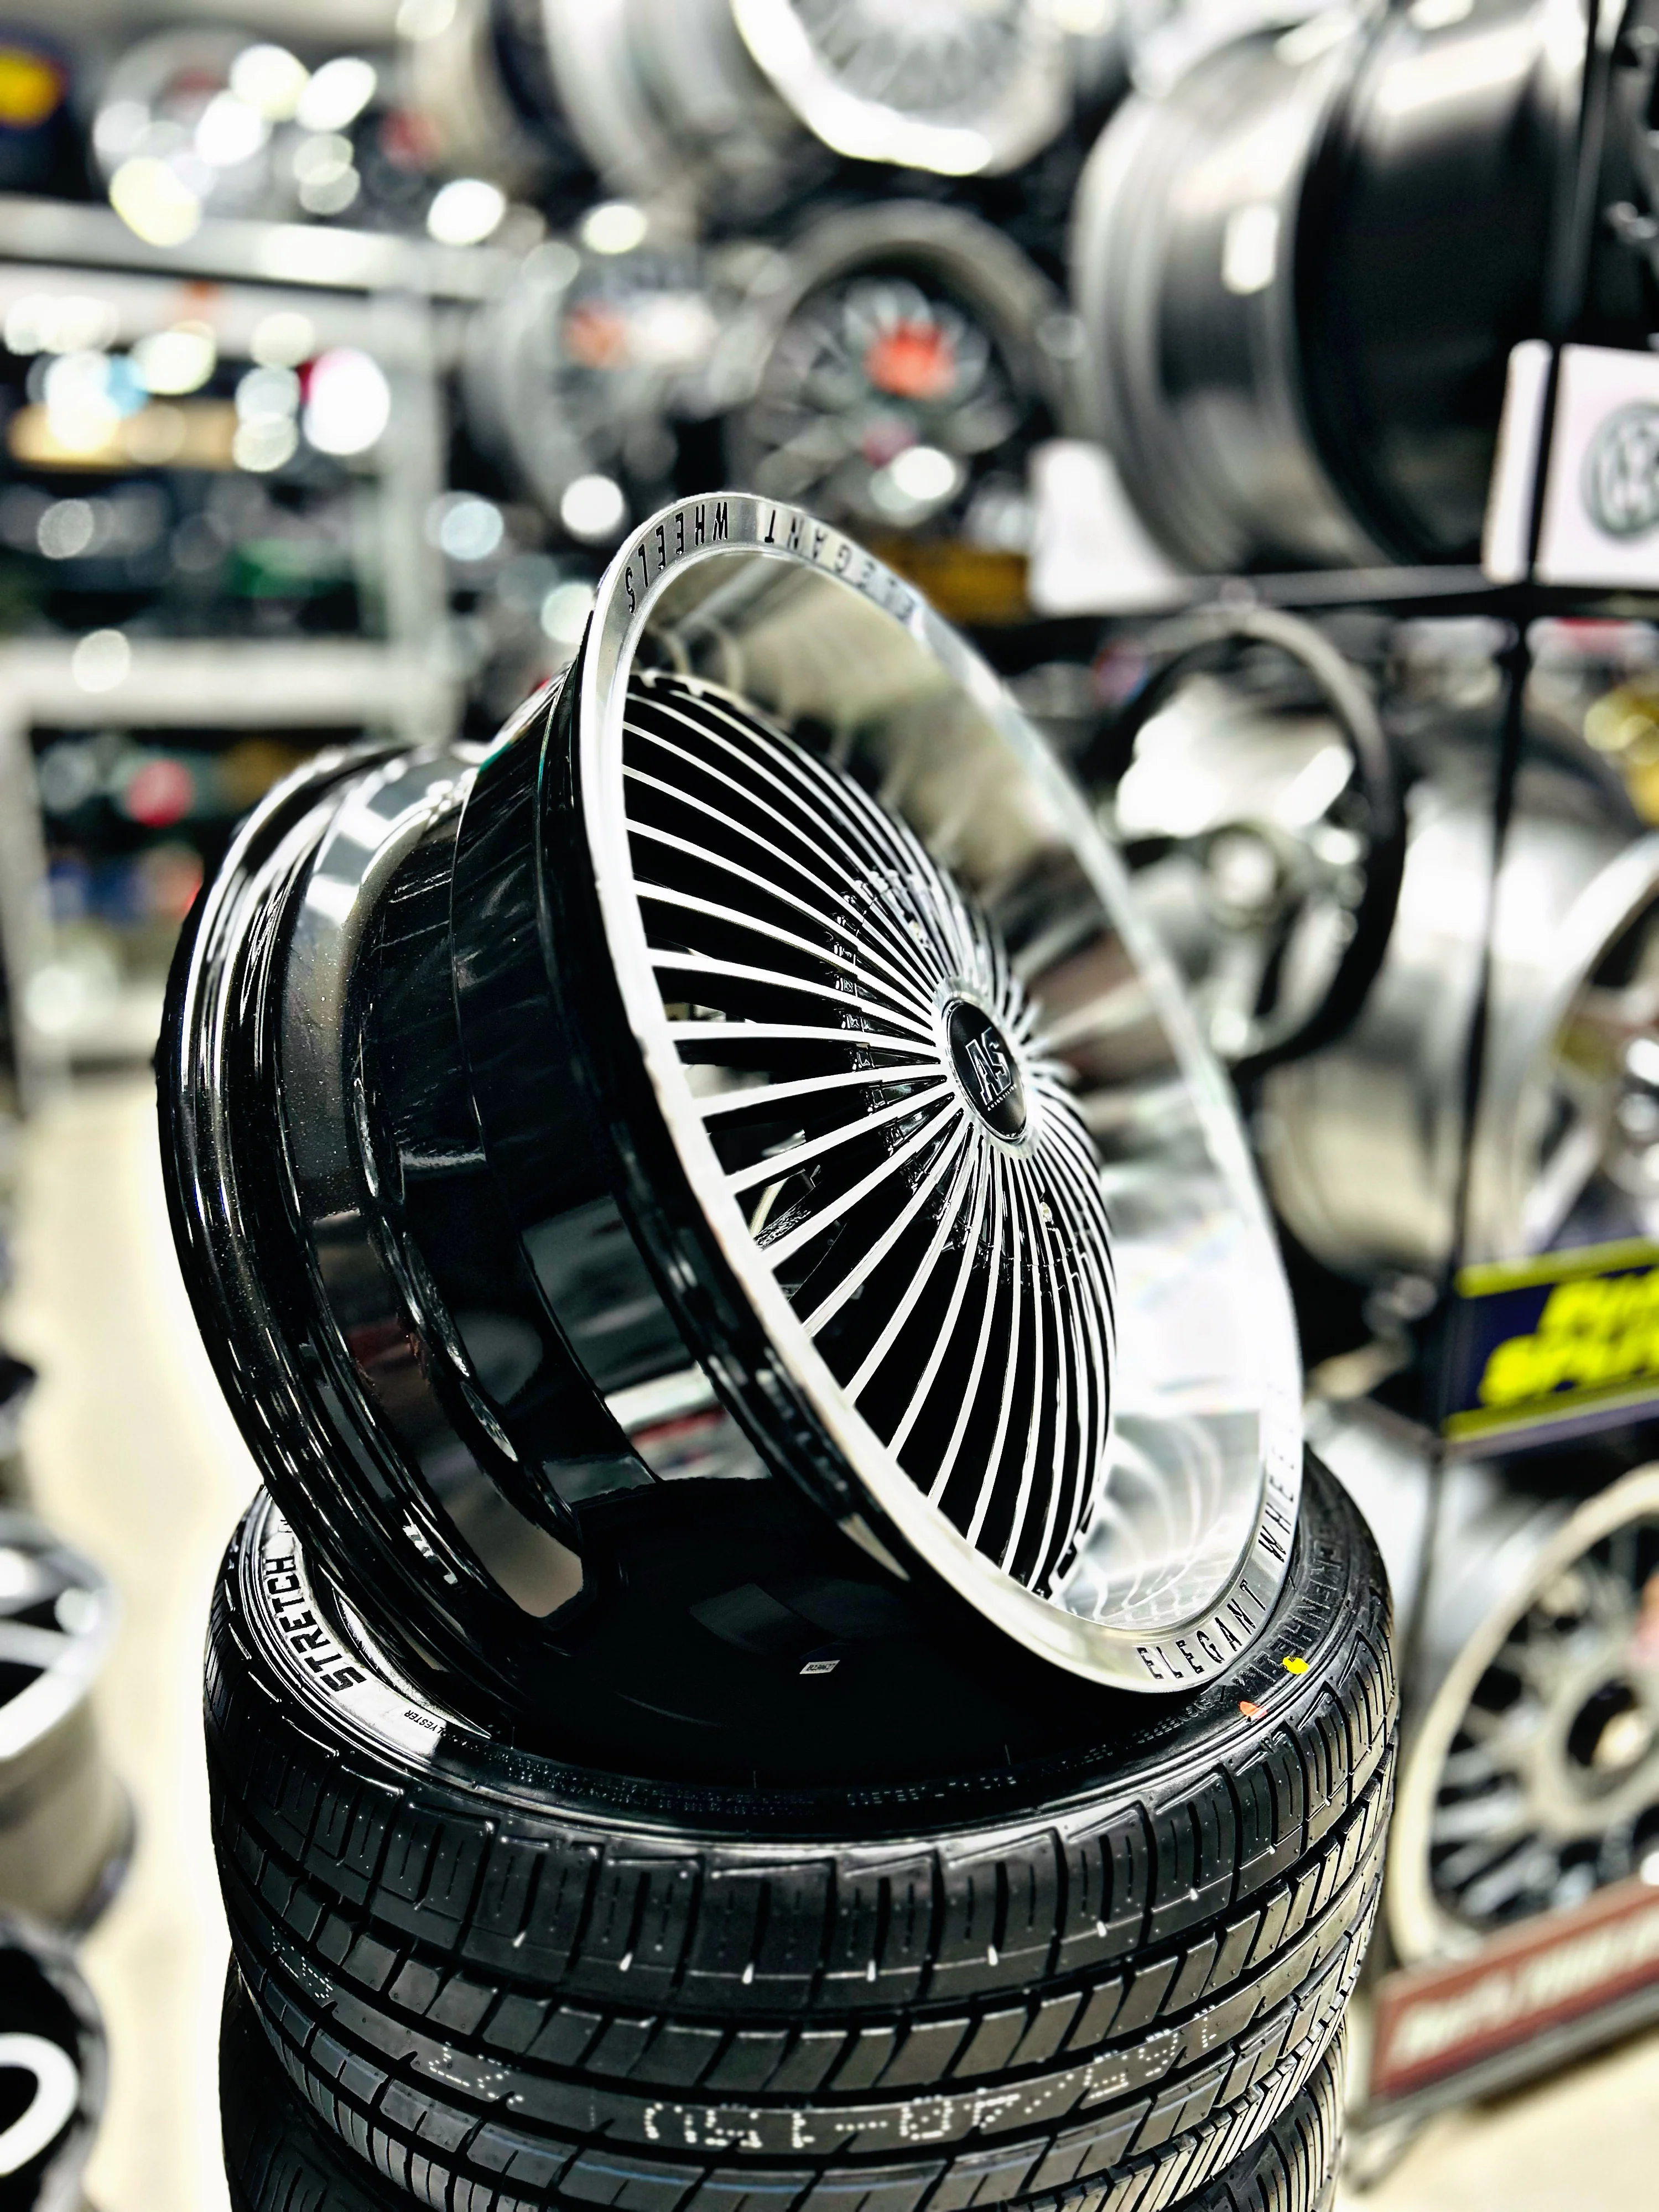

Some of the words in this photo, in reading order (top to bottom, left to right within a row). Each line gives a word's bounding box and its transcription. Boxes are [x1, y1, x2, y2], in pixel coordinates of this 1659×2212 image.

[625, 502, 728, 615] WHEELS
[966, 1027, 1011, 1105] AS
[262, 1555, 367, 1692] STRETCH
[1137, 1579, 1266, 1679] ELEGANT
[404, 1709, 448, 1737] LYESTER
